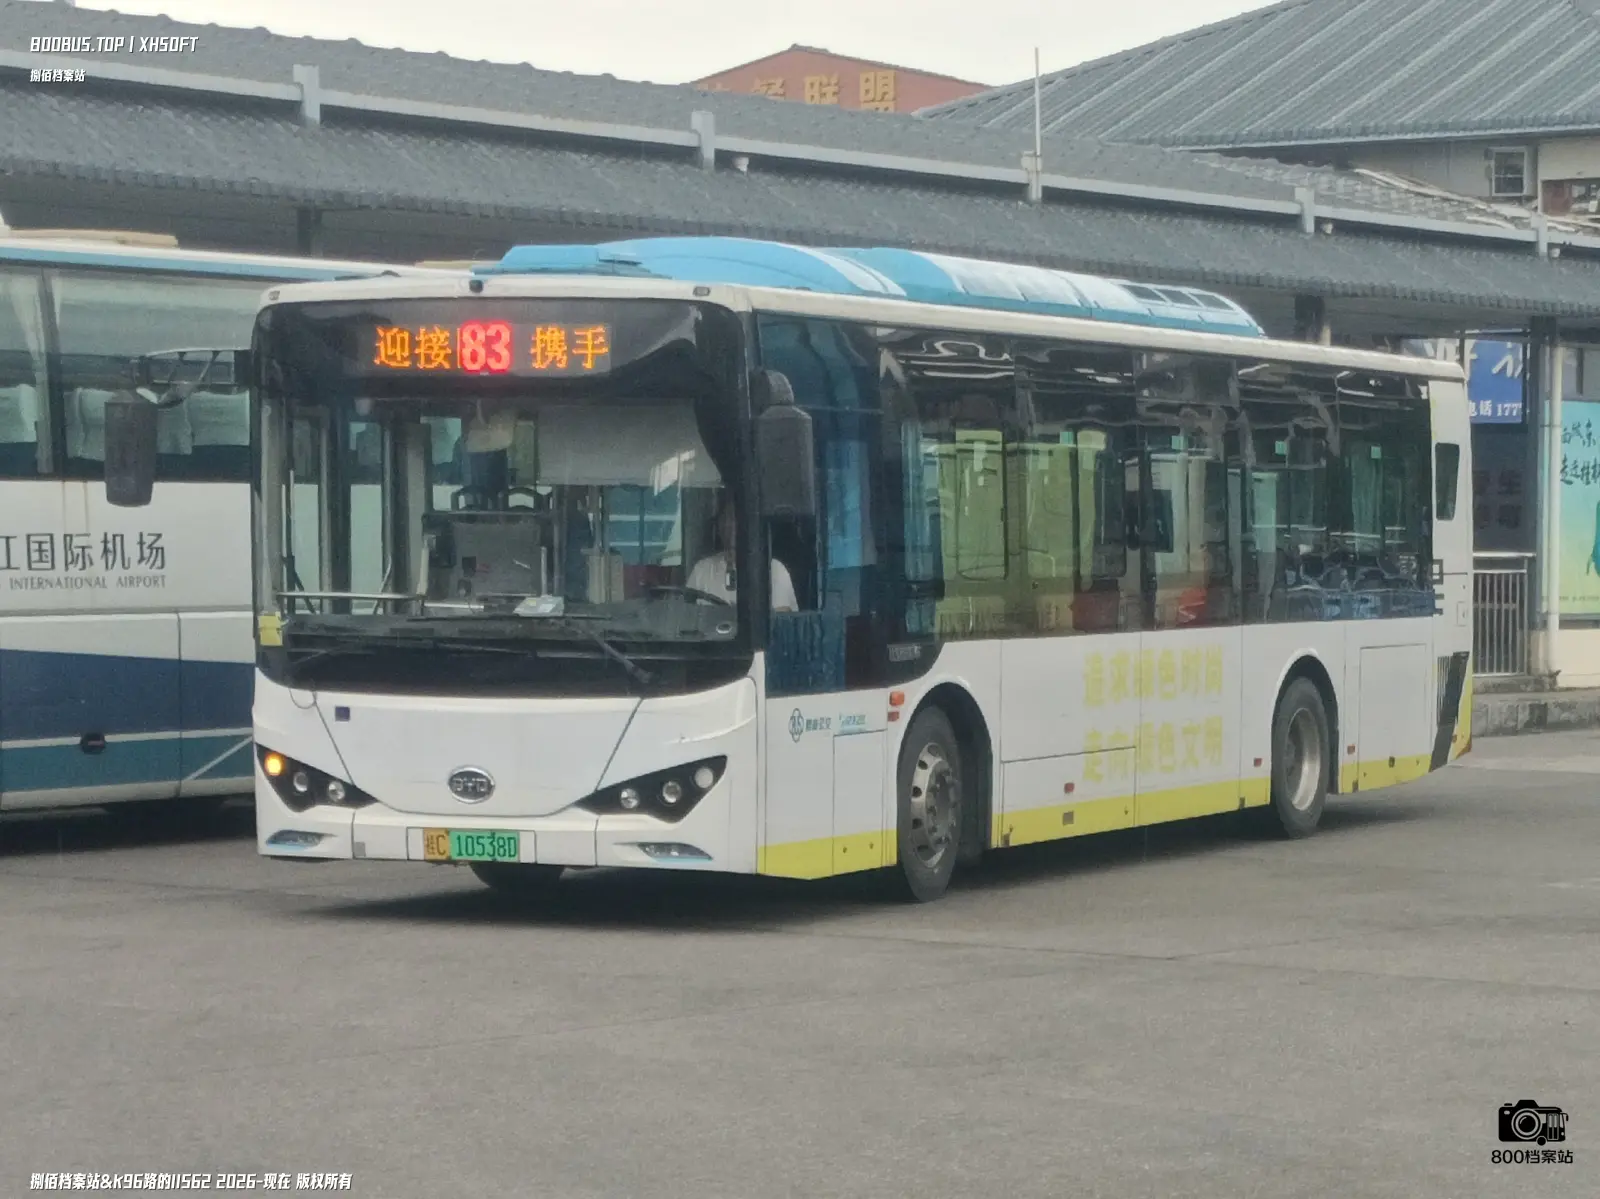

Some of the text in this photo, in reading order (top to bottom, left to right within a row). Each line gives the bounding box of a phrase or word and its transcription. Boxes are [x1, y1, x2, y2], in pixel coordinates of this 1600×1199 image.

[374, 322, 609, 373] 迎接 83 携手
[1497, 402, 1522, 417] 177
[9, 575, 166, 590] INTERNATIONAL AIRPORT
[456, 833, 518, 858] 10538D
